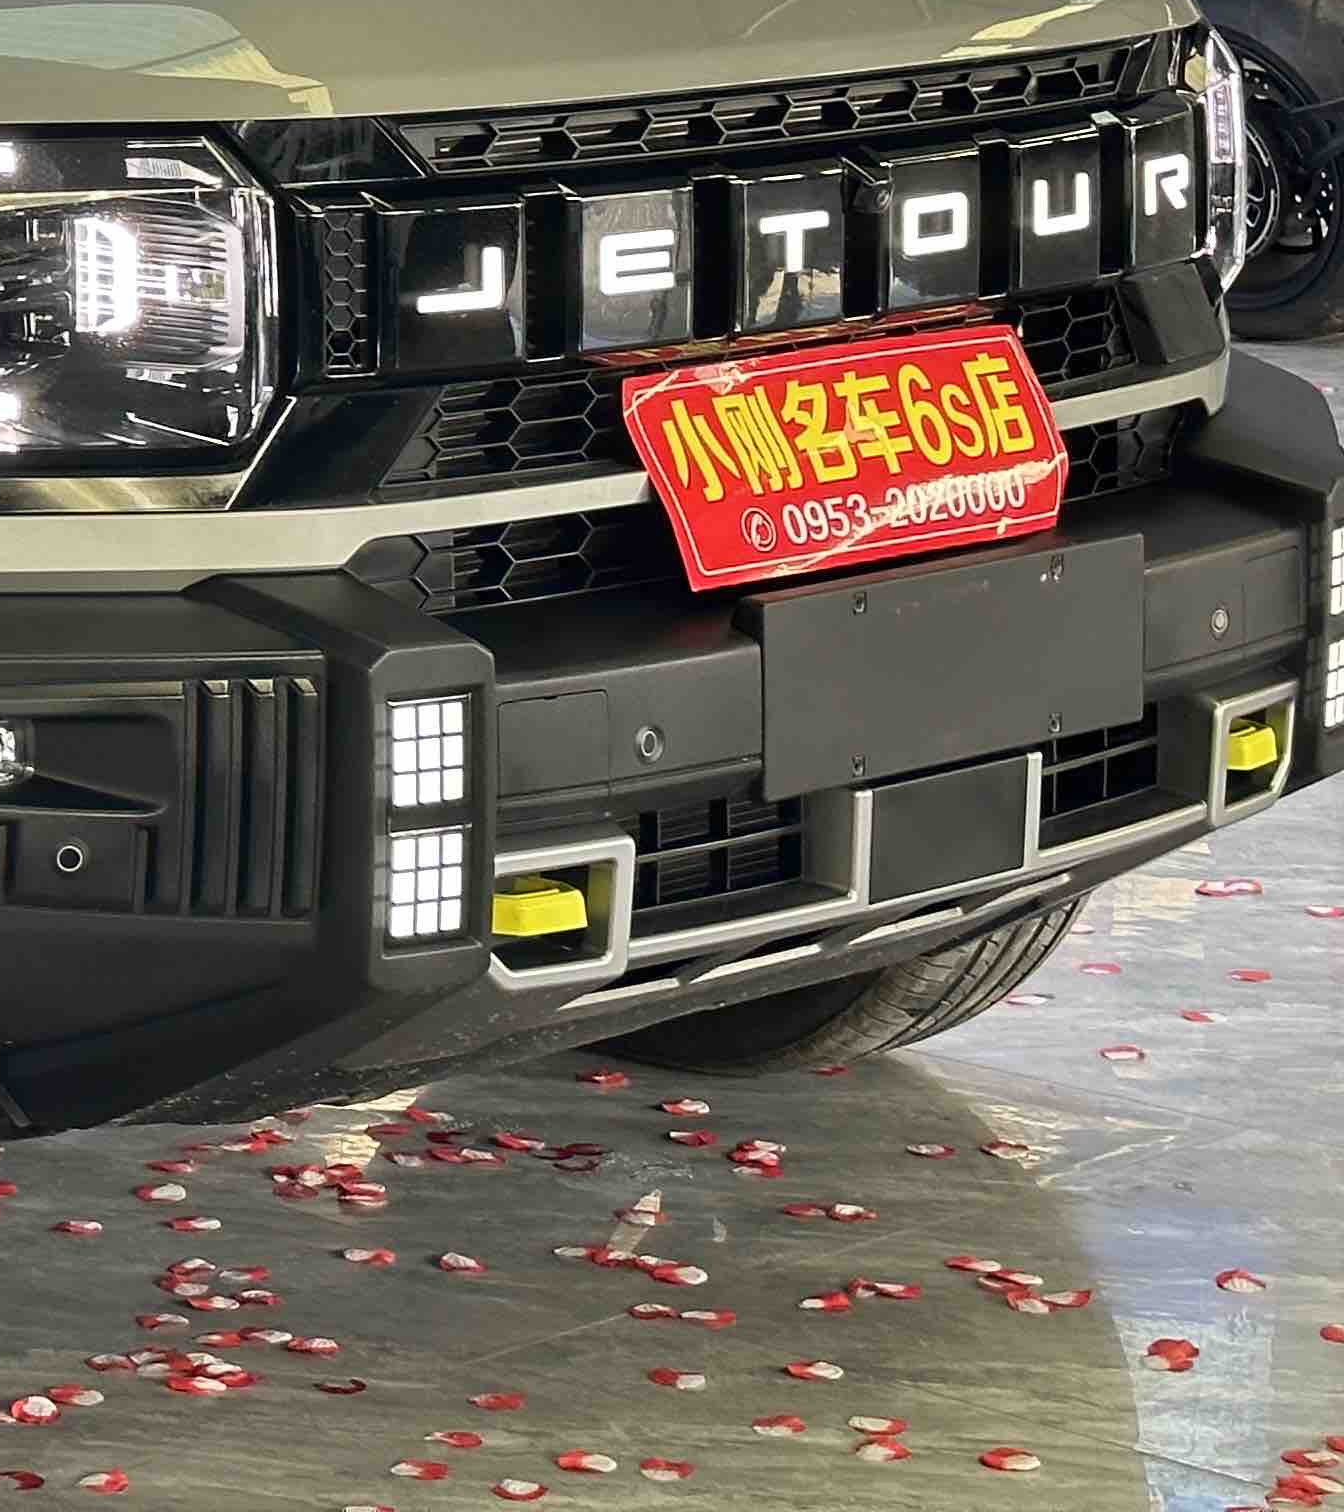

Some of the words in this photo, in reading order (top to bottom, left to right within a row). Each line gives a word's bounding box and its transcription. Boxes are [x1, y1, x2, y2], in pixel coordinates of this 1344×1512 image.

[417, 152, 1190, 316] JETOUR
[661, 351, 1036, 503] 小刚名车6s店
